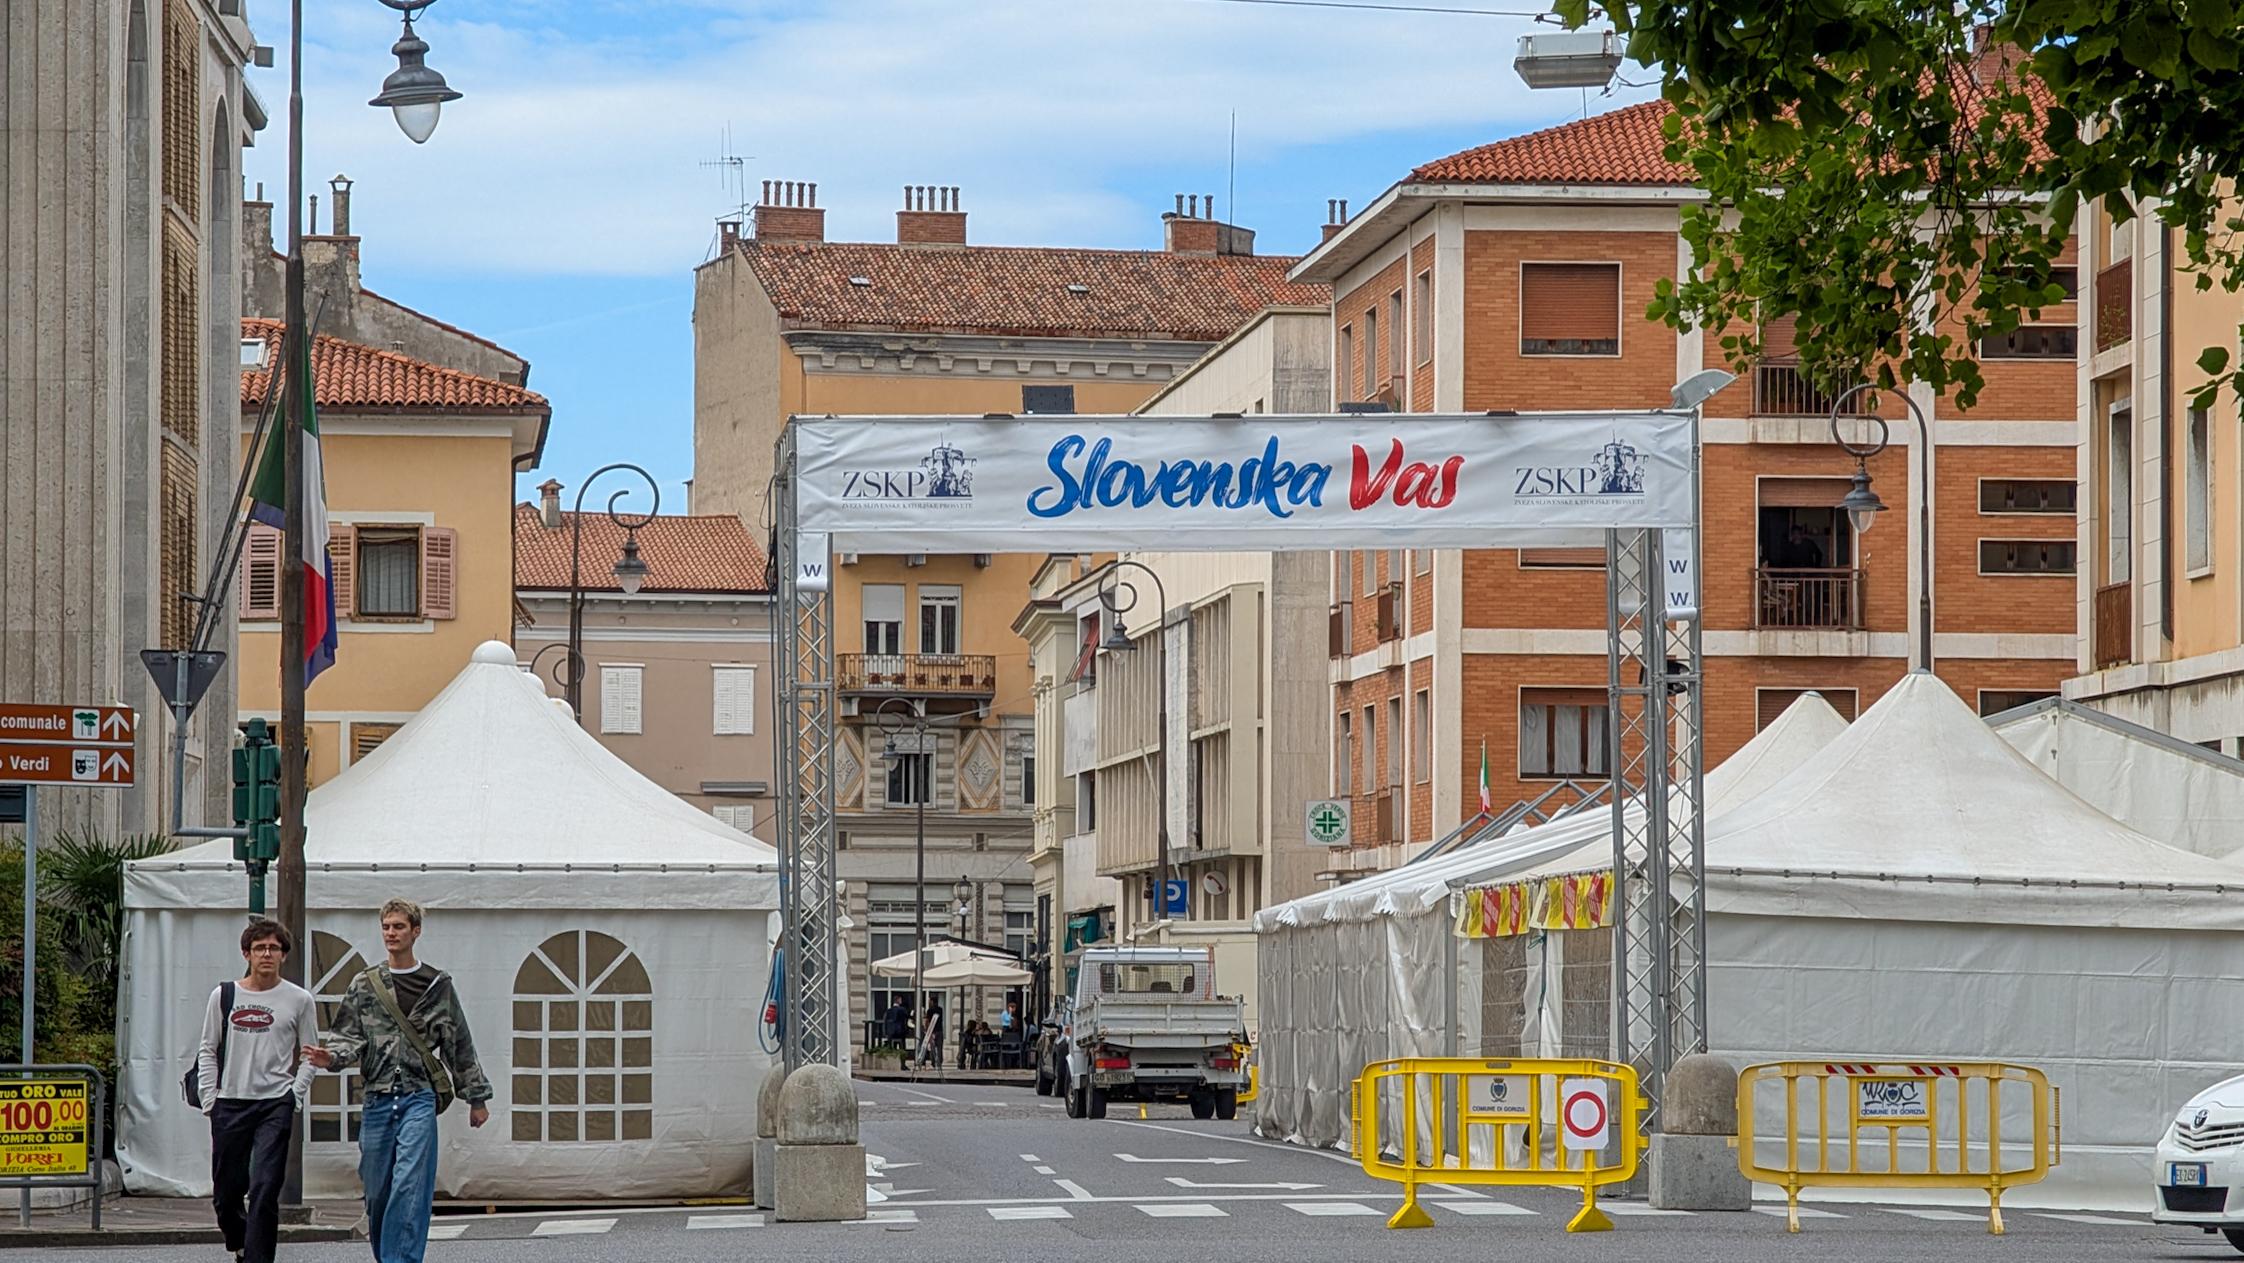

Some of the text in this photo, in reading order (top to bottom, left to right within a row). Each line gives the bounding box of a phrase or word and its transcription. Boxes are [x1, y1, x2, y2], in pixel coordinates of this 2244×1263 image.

[842, 470, 925, 498] ZSKP
[1026, 434, 1466, 519] Slovenska Vas
[1514, 467, 1597, 495] ZSKP
[803, 564, 822, 577] W
[1, 714, 66, 730] comunale
[10, 756, 49, 771] Verdi
[21, 1085, 56, 1098] ORO
[60, 1089, 83, 1097] VALE
[48, 1133, 74, 1143] ORO
